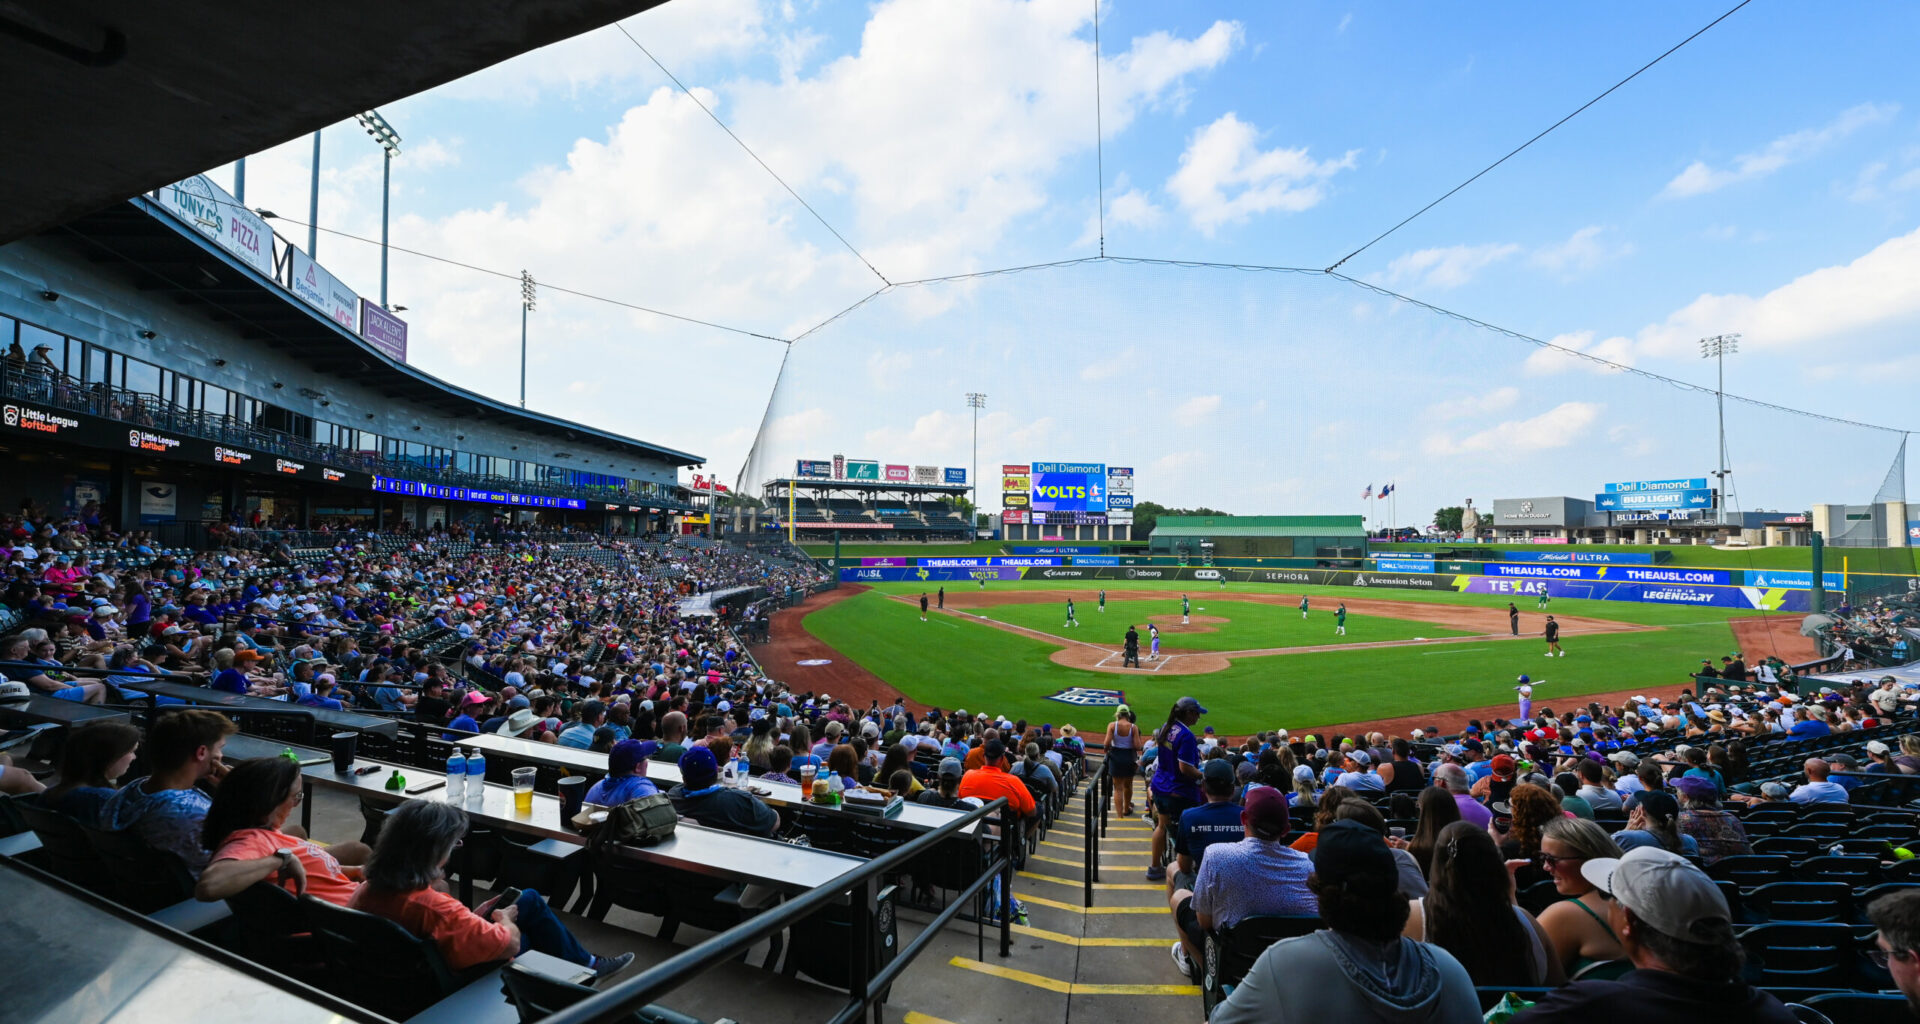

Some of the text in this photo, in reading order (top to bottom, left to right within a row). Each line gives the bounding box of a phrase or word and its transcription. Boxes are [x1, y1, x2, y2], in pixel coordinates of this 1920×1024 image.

[172, 184, 205, 220] TONY
[231, 217, 260, 255] PIZZA
[295, 277, 325, 308] Benjamin
[370, 313, 403, 339] JACK ALLEN'S
[21, 408, 78, 428] Little League
[21, 418, 58, 433] Softball
[141, 432, 180, 447] Little League
[141, 440, 166, 452] Softball
[1038, 464, 1056, 472] Dell
[1059, 464, 1100, 473] Diamond
[1616, 480, 1690, 491] Dell Diamond
[1035, 486, 1086, 498] VOLTS
[1623, 494, 1680, 503] BUD LIGHT
[1616, 512, 1689, 521] BULLPEN BAR
[857, 569, 882, 577] AUSL
[969, 571, 998, 579] VOLTS
[1266, 572, 1310, 581] SEPHORA
[1499, 566, 1580, 577] THEAUSL.COM
[1626, 570, 1714, 583] THEAUSL.COM
[1369, 576, 1433, 586] Ascension Seton
[1770, 577, 1811, 587] Ascension
[1643, 590, 1715, 602] LEGENDARY
